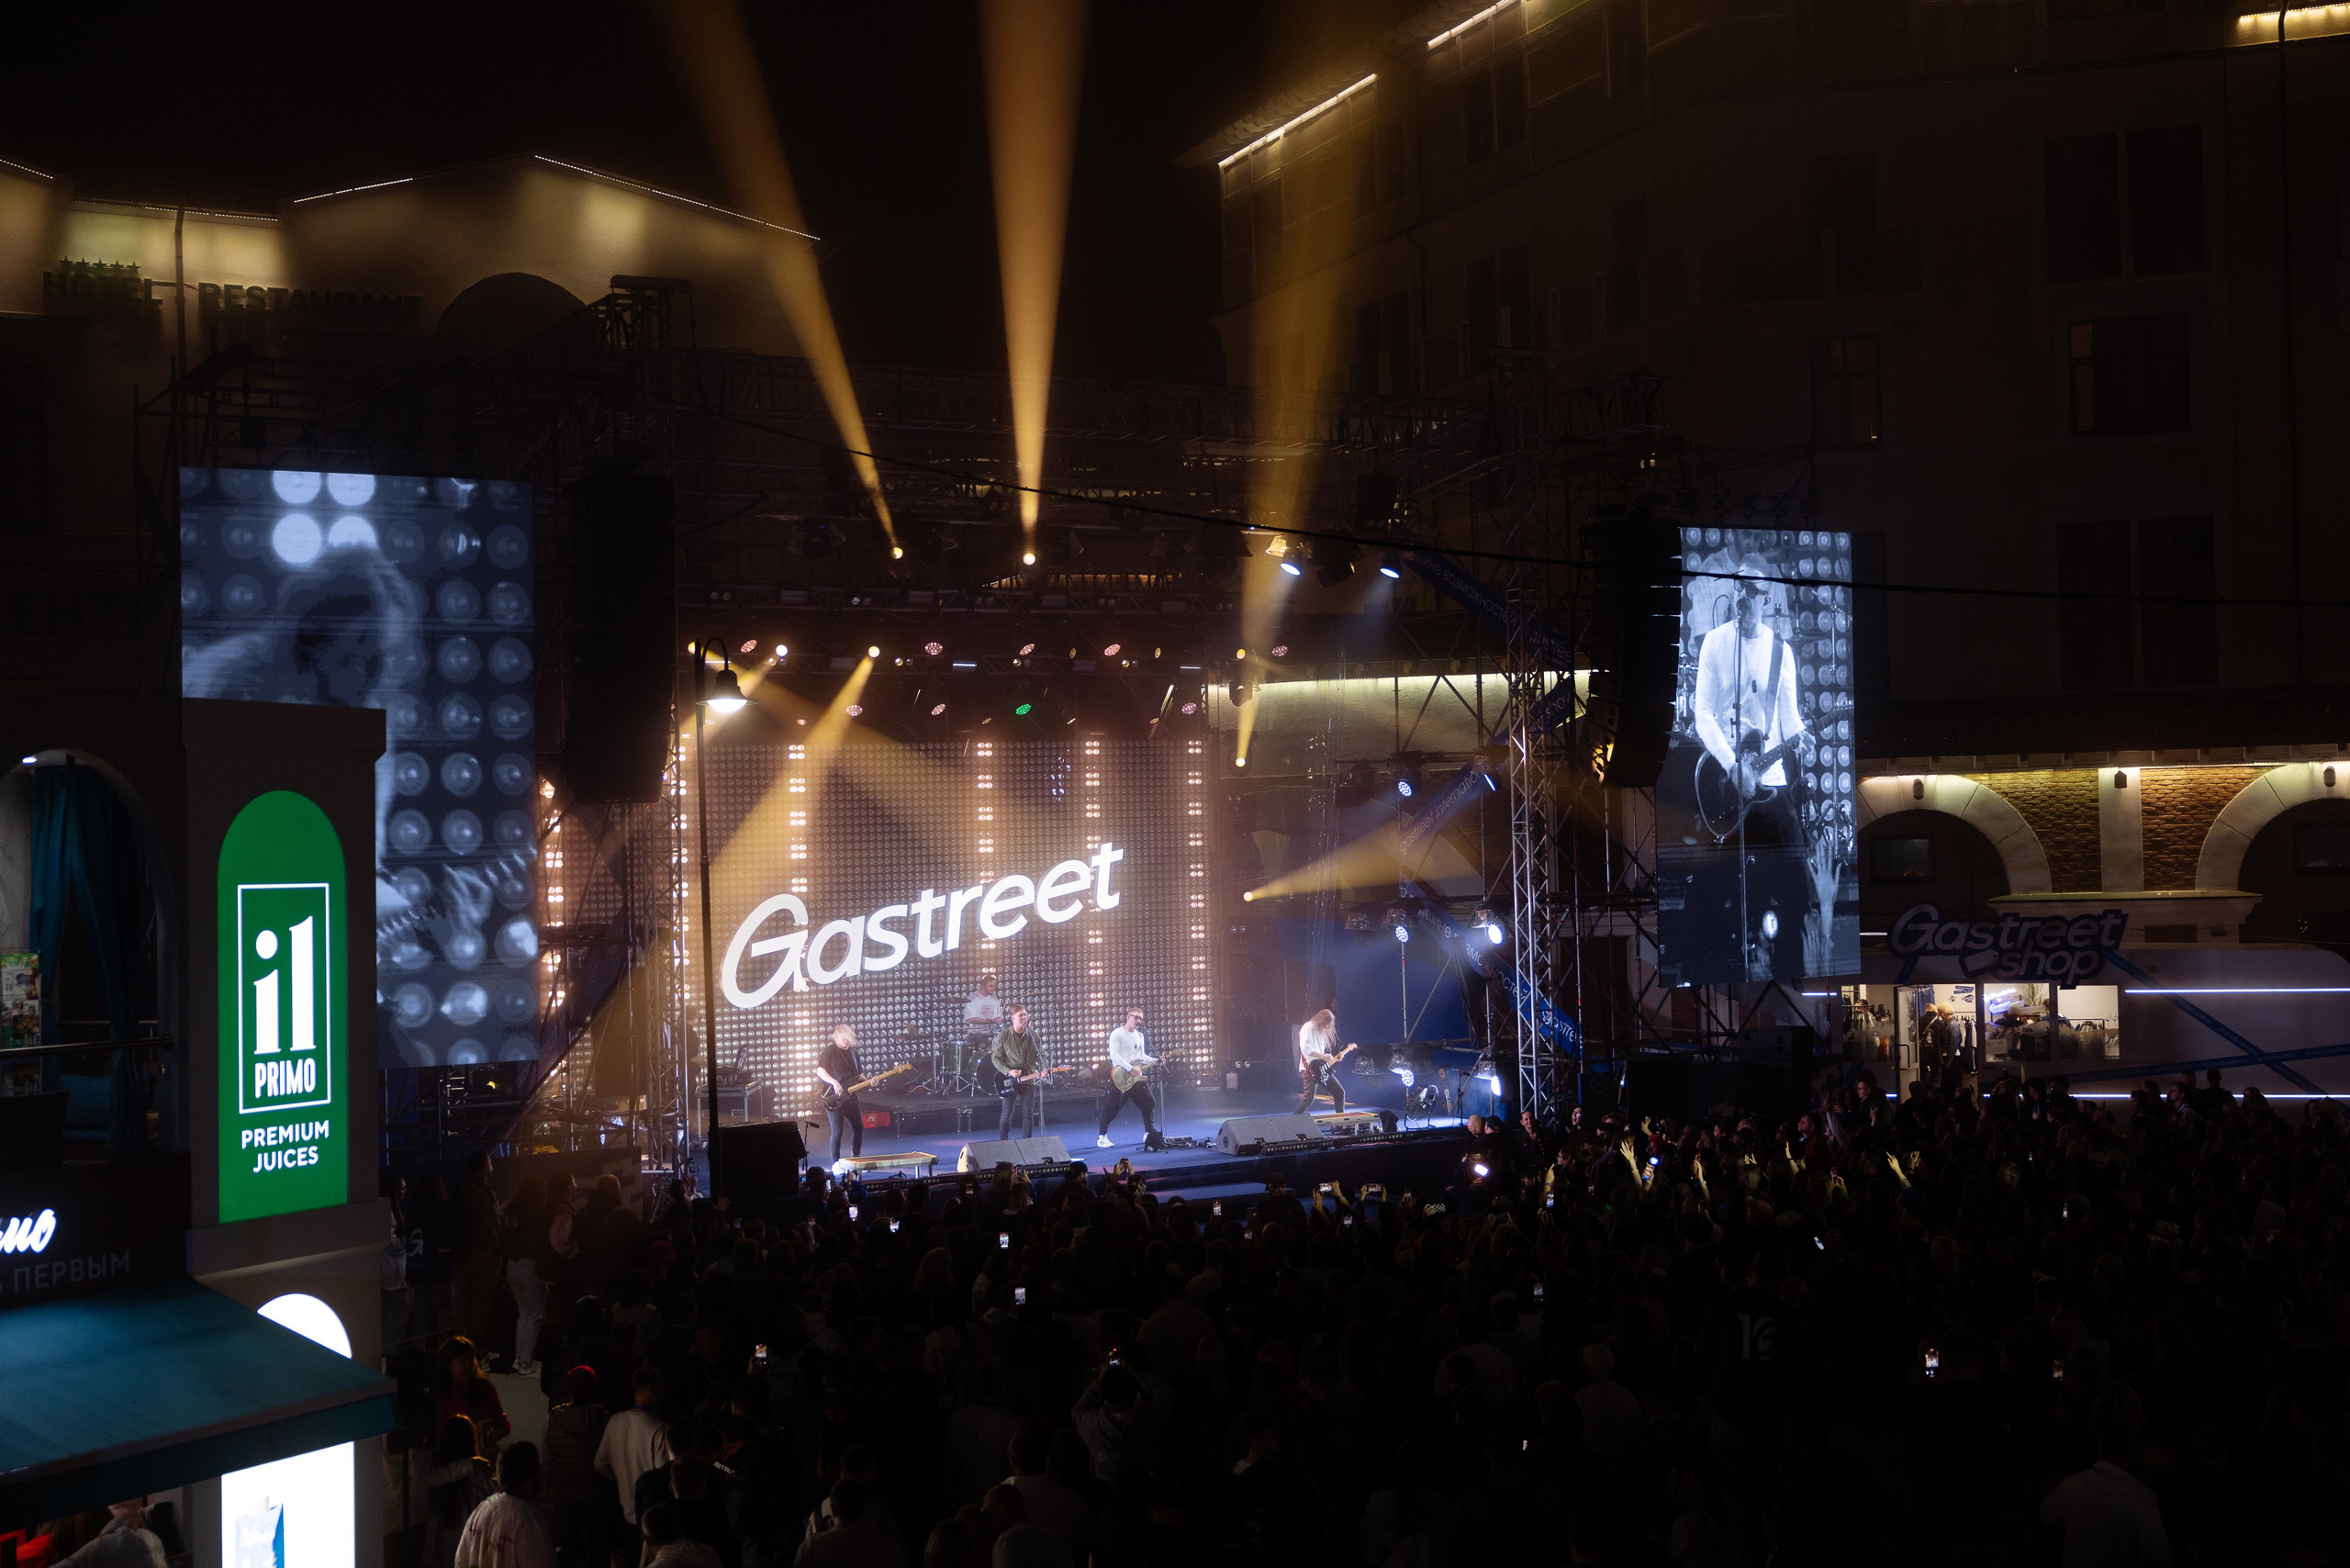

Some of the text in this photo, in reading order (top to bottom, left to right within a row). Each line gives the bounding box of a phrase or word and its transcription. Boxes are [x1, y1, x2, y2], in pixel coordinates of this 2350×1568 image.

[42, 270, 424, 320] HOTEL RESTAURANT
[719, 841, 1125, 1009] Gastreet
[1890, 902, 2122, 955] Gastreet
[253, 915, 317, 1055] il
[1996, 940, 2100, 985] shop
[254, 1058, 317, 1099] PRIMO
[241, 1119, 330, 1149] PREMIUM
[252, 1146, 319, 1173] JUICES
[13, 1249, 131, 1294] ПЕРВЫМ
